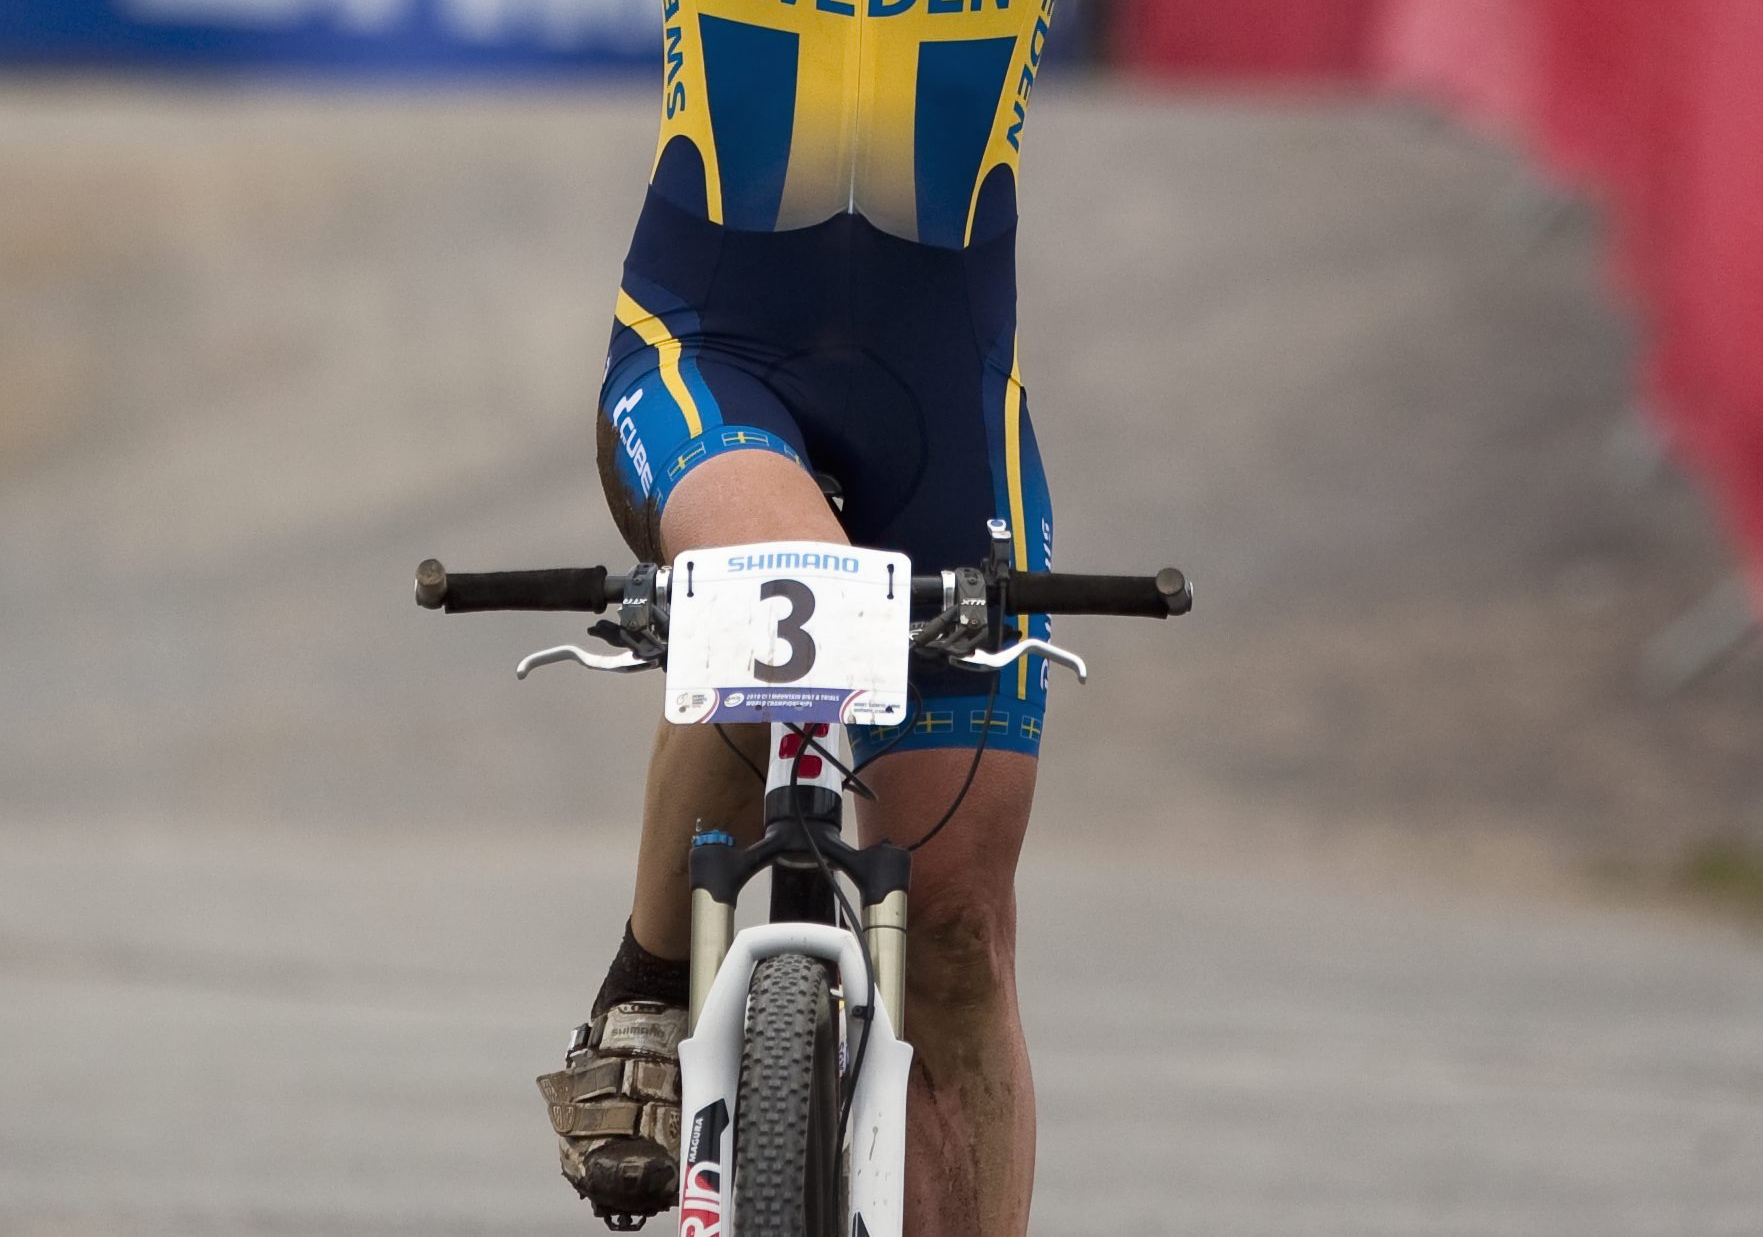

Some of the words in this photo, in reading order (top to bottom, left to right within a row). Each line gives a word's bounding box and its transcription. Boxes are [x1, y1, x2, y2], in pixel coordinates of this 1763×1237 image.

[620, 417, 653, 499] CUBE
[727, 553, 859, 574] SHIMANO
[753, 578, 817, 684] 3
[689, 1117, 704, 1162] MAGURA
